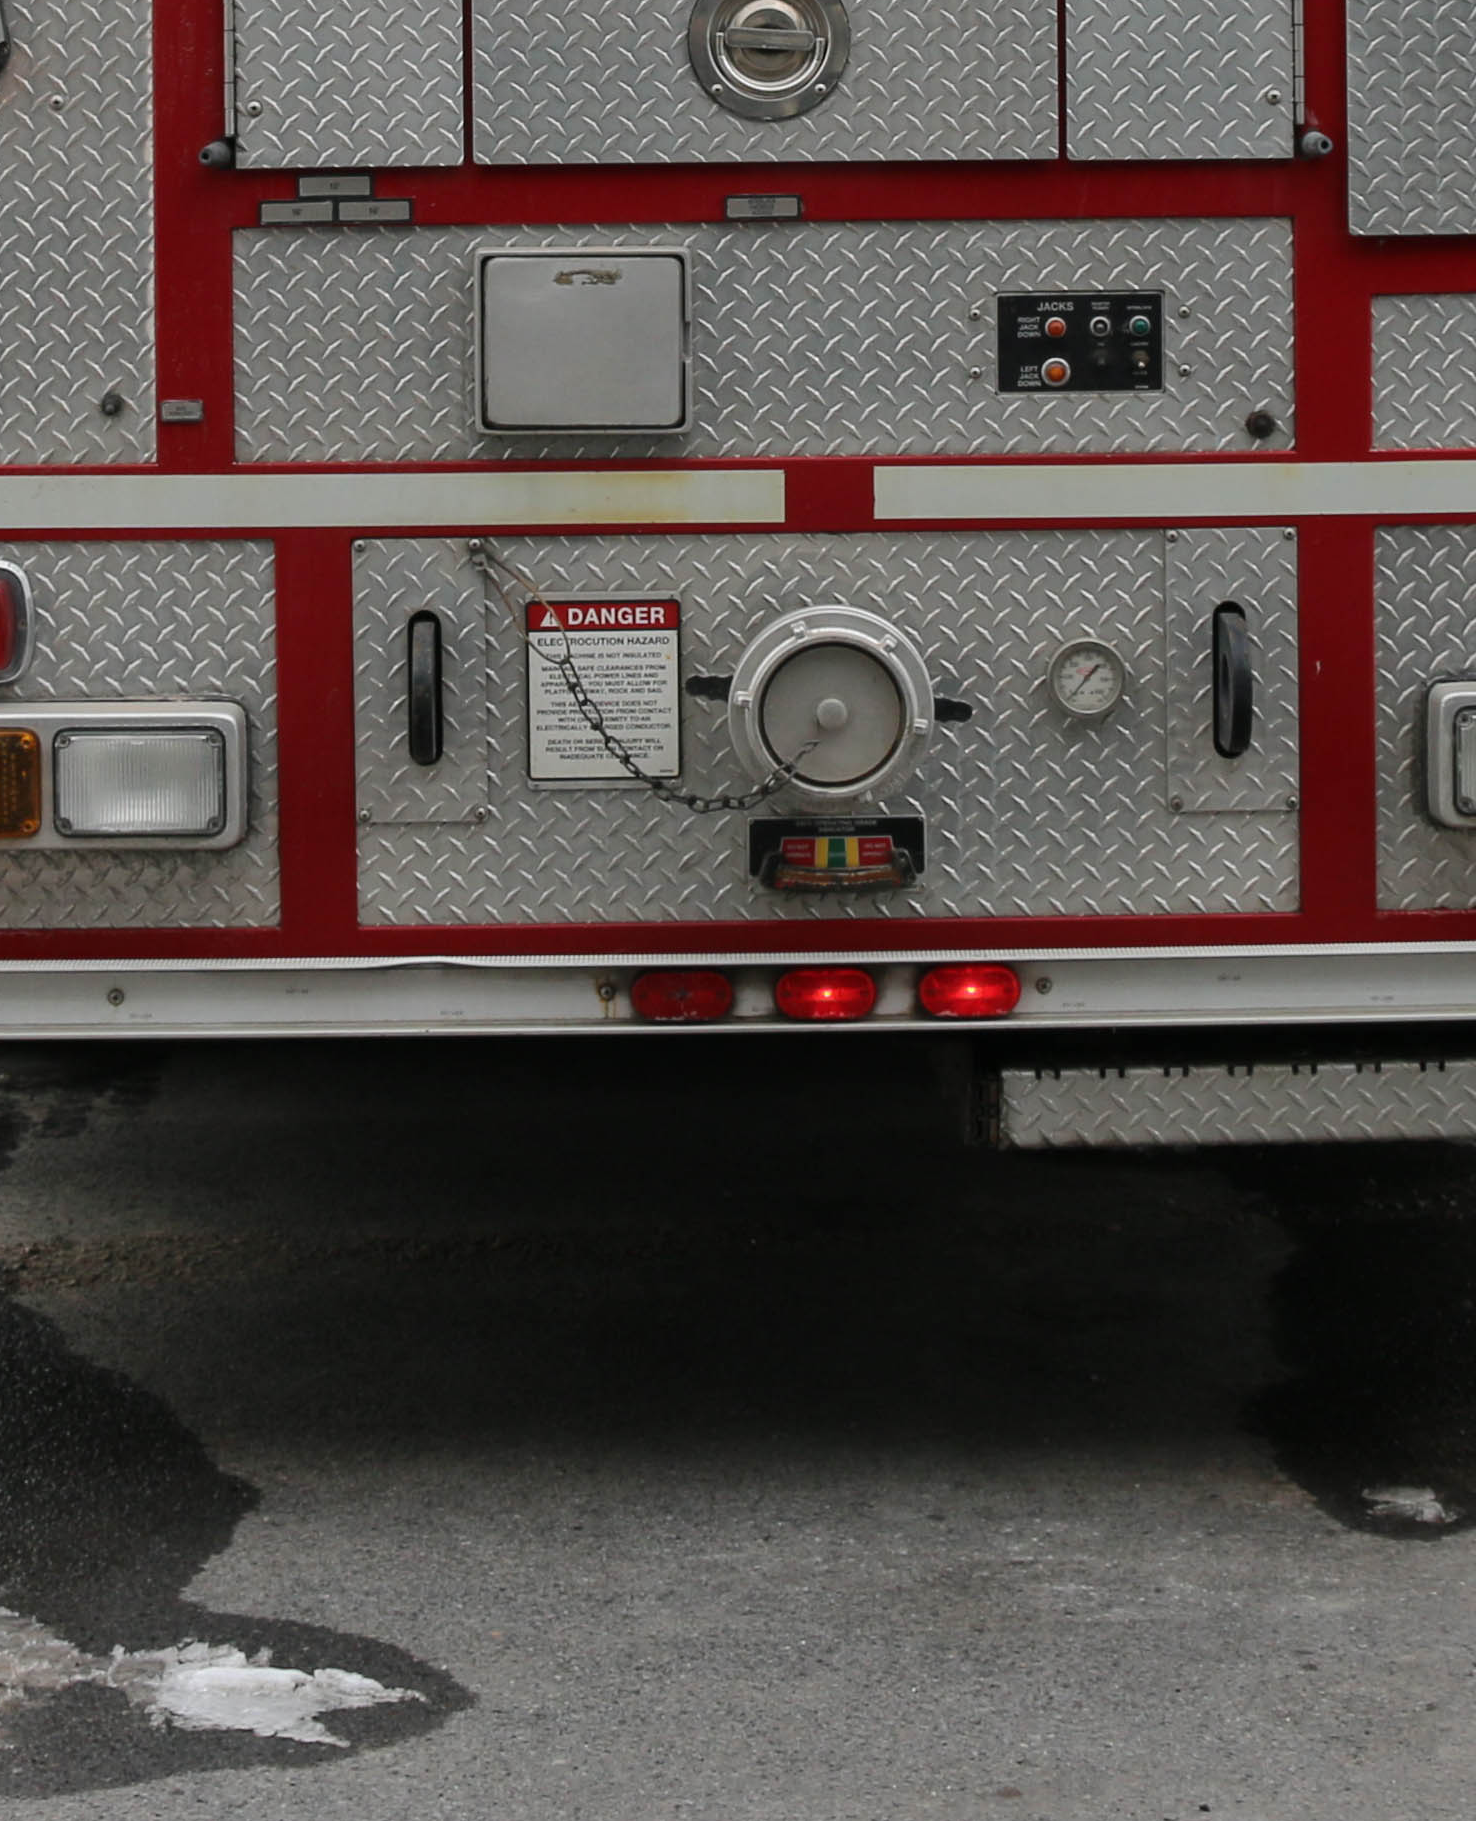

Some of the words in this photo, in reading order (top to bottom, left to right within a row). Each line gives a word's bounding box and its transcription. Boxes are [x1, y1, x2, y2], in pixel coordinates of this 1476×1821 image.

[1036, 302, 1074, 311] JACKS
[567, 607, 665, 625] DANGER
[537, 637, 624, 647] ELECROCUTION
[628, 636, 670, 645] HAZARD
